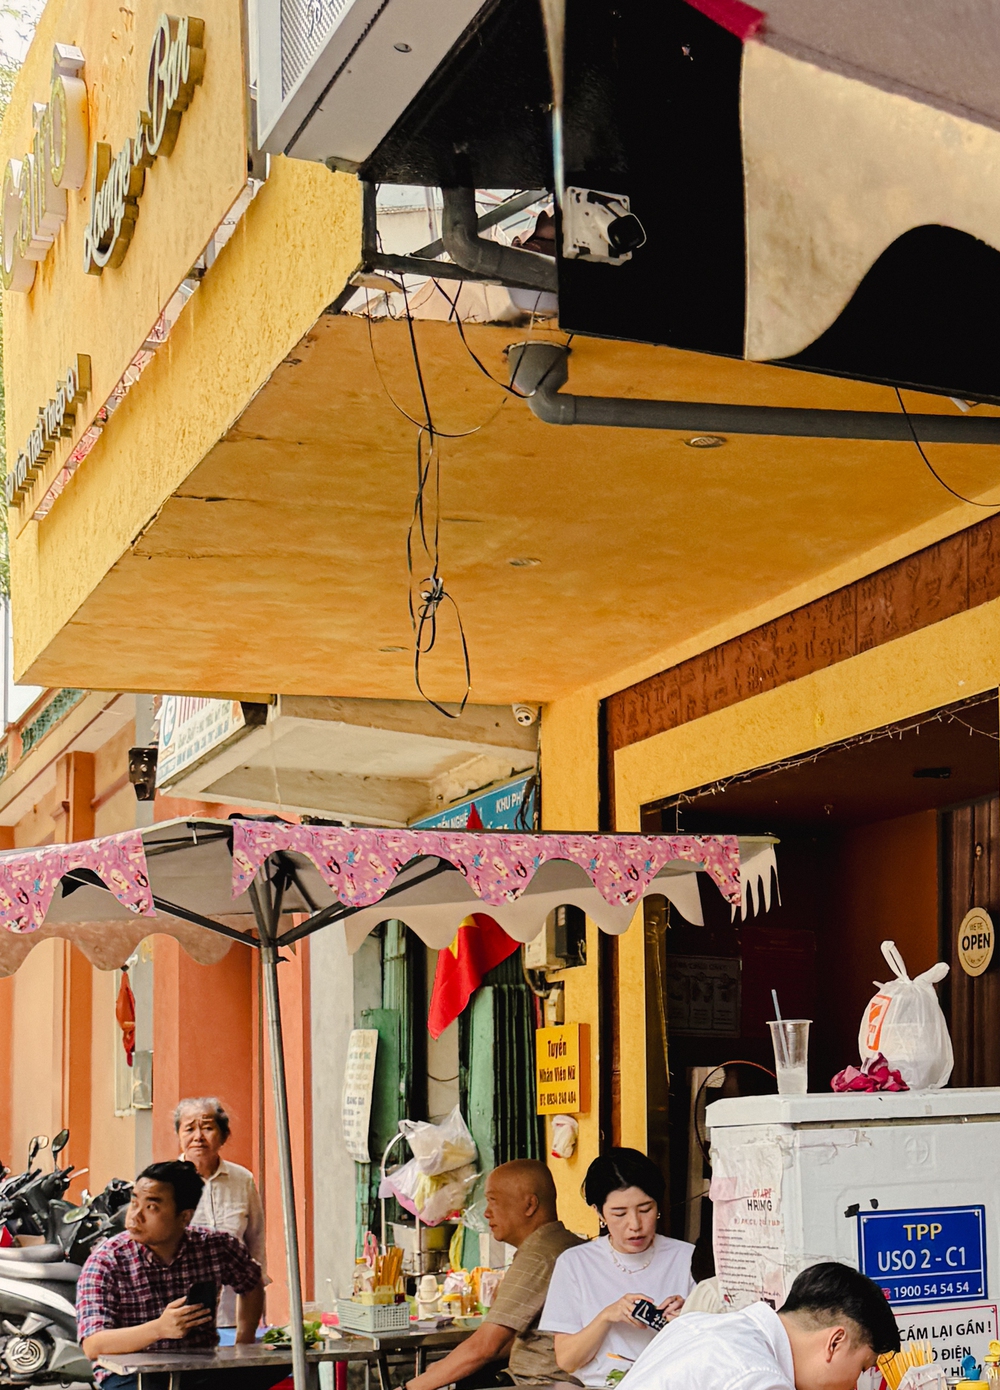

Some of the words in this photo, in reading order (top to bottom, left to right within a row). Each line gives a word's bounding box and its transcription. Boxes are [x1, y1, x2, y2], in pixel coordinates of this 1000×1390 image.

[496, 795, 511, 814] KHU
[962, 932, 990, 951] OPEN
[547, 1034, 566, 1059] Tuyển
[903, 1223, 942, 1241] TPP
[877, 1249, 916, 1272] USO
[920, 1248, 931, 1269] 2
[945, 1246, 966, 1266] C1
[894, 1285, 921, 1298] 1900
[924, 1284, 937, 1295] 54
[940, 1283, 953, 1294] 54
[956, 1282, 969, 1293] 54
[898, 1324, 928, 1341] CẤM
[932, 1325, 952, 1340] LẠI
